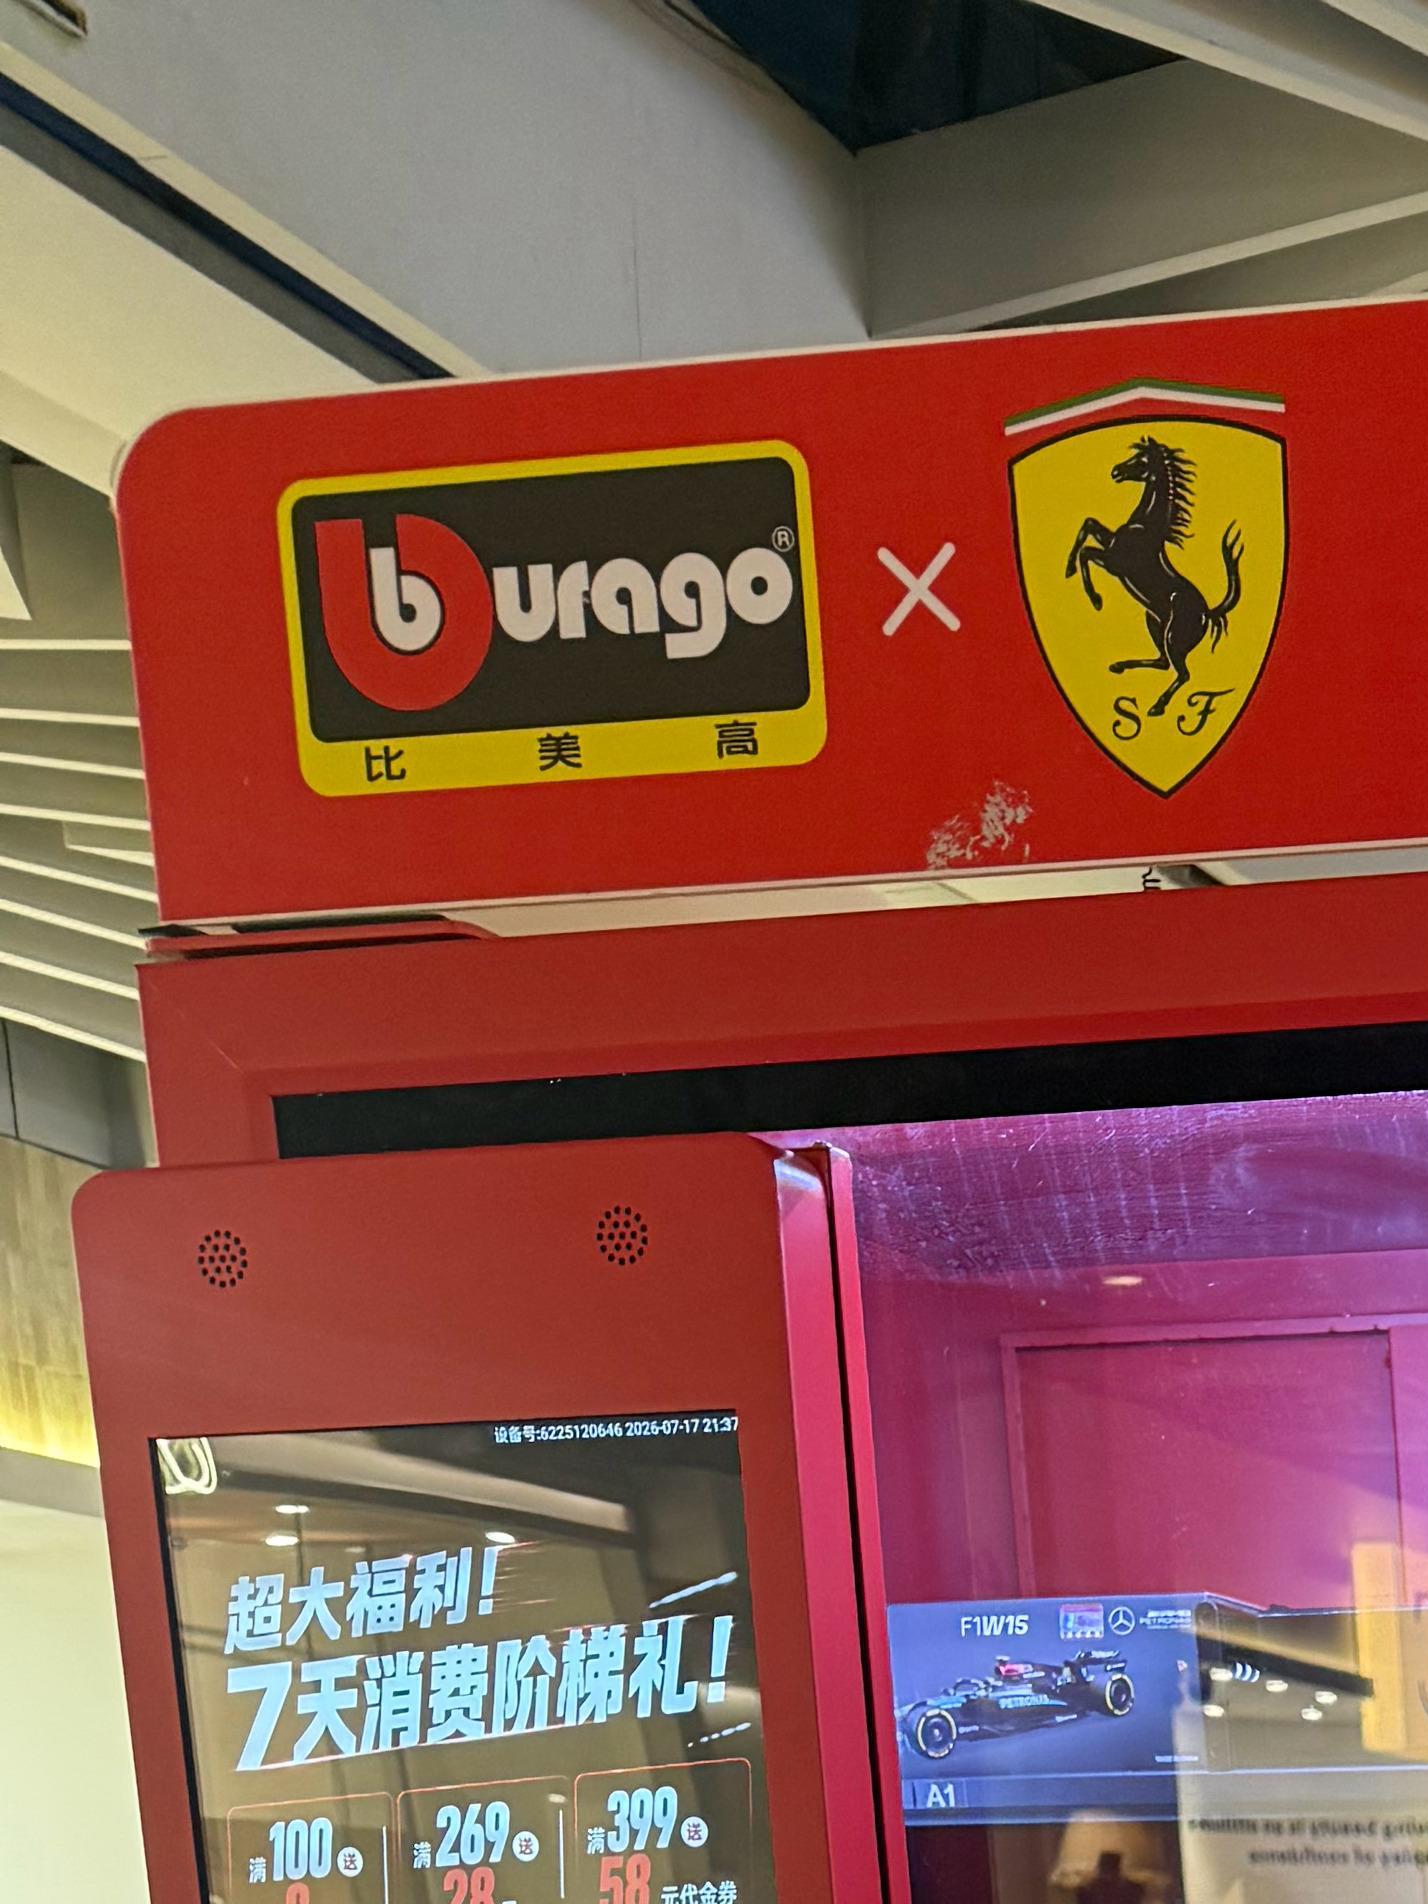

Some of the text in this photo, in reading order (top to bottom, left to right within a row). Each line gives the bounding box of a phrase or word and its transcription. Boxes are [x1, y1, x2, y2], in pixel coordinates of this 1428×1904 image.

[363, 718, 761, 783] 比美高
[626, 1418, 699, 1437] 2026-07-17
[927, 1784, 955, 1807] A1
